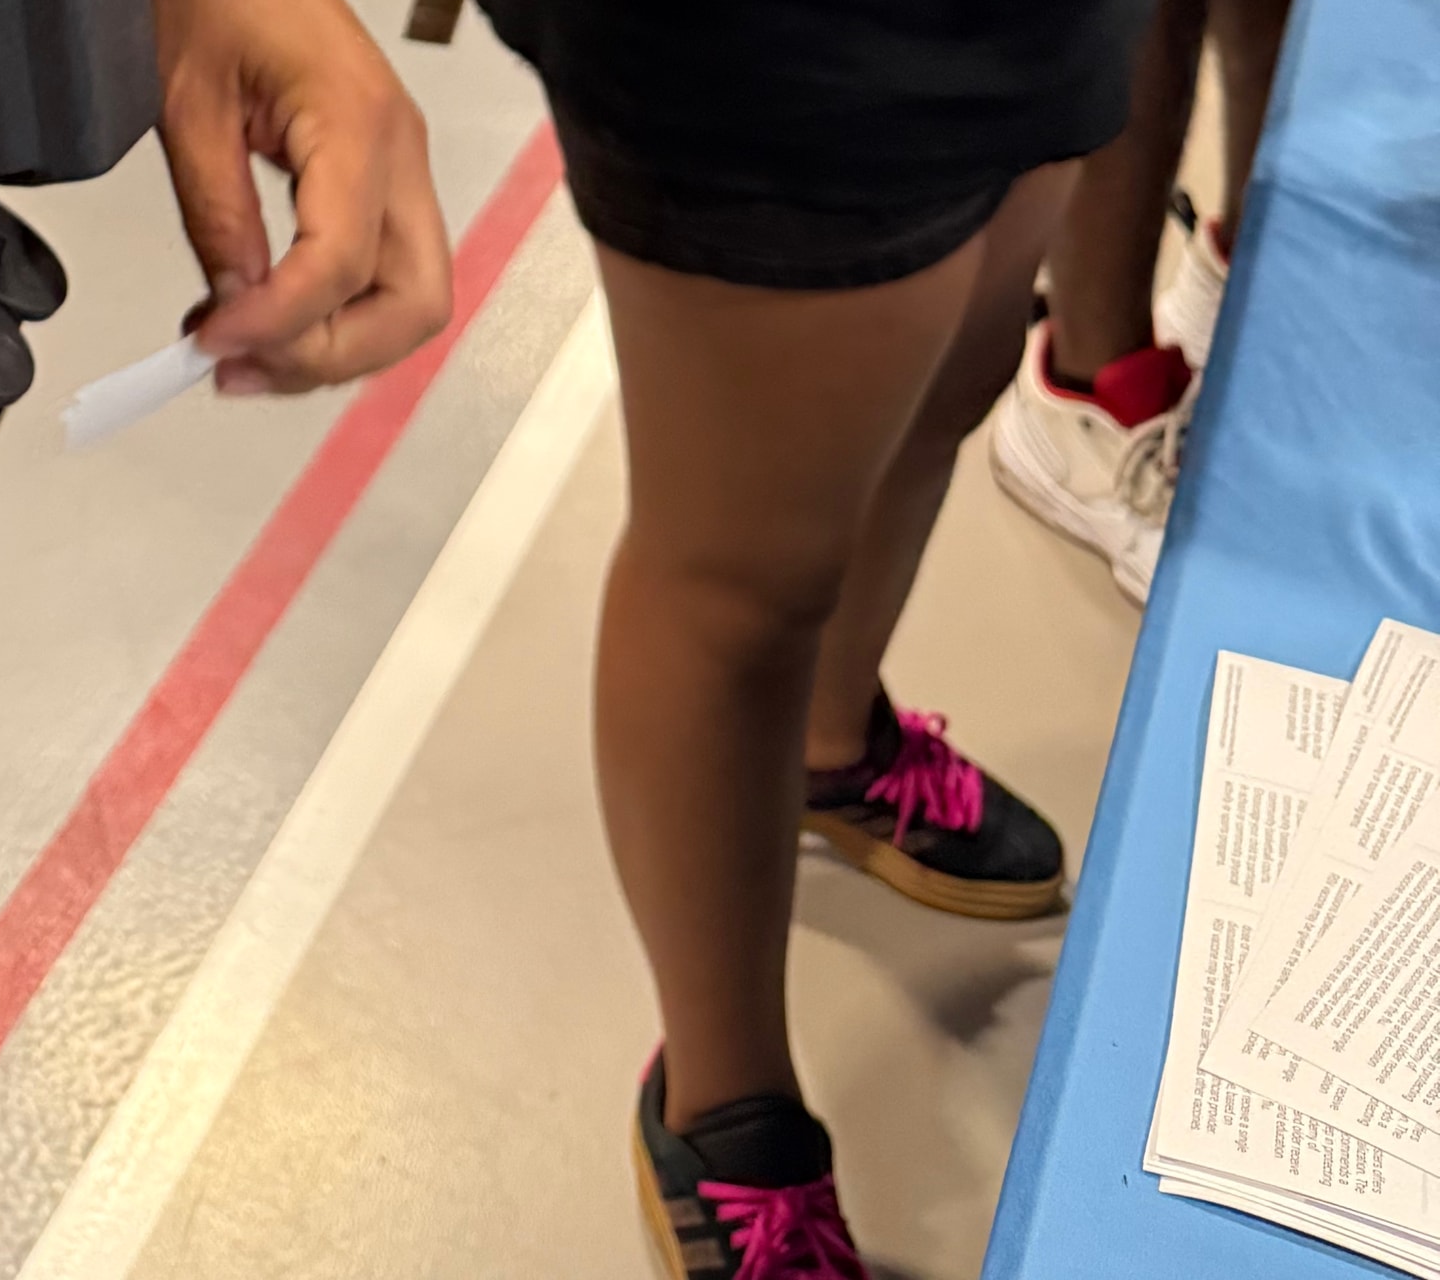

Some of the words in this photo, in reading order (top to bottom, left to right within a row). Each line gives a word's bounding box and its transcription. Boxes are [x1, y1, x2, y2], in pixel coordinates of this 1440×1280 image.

[1376, 980, 1391, 994] and
[1398, 967, 1425, 998] vaccinated
[1349, 1007, 1371, 1029] receive
[1388, 1024, 1403, 1039] and
[1403, 1032, 1418, 1047] and
[1332, 1033, 1351, 1053] single
[1368, 1036, 1394, 1067] education
[1376, 1062, 1397, 1084] receive
[1274, 1121, 1287, 1159] education
